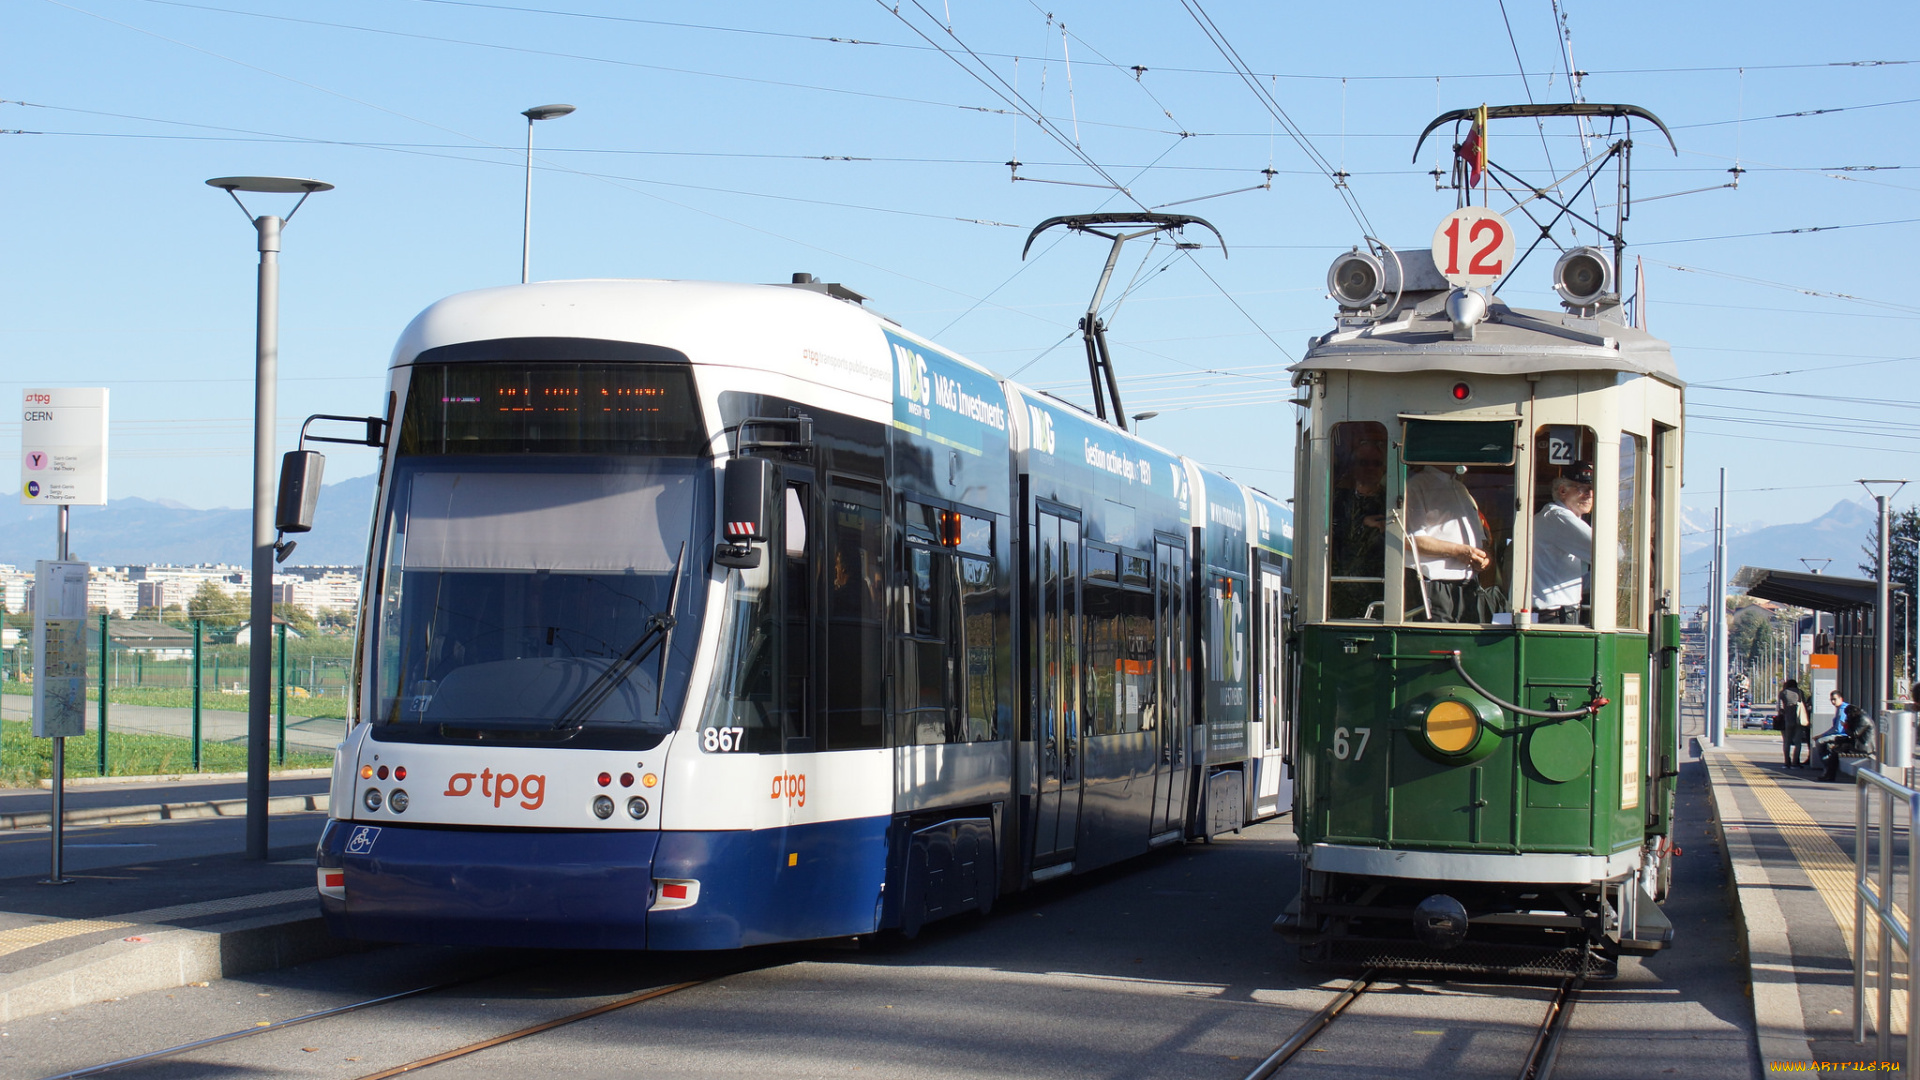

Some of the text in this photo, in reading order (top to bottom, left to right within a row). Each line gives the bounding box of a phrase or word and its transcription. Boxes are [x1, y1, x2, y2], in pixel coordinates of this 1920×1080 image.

[1444, 218, 1504, 275] 12
[893, 343, 930, 406] M&G
[24, 411, 53, 421] CERN
[932, 370, 1005, 431] M&G Investments
[1028, 404, 1055, 455] M&G
[32, 454, 42, 466] Y
[1084, 437, 1106, 470] Gestion
[1552, 442, 1573, 460] 22
[1209, 586, 1244, 684] M&G
[704, 726, 744, 752] 867
[1333, 726, 1371, 761] 67
